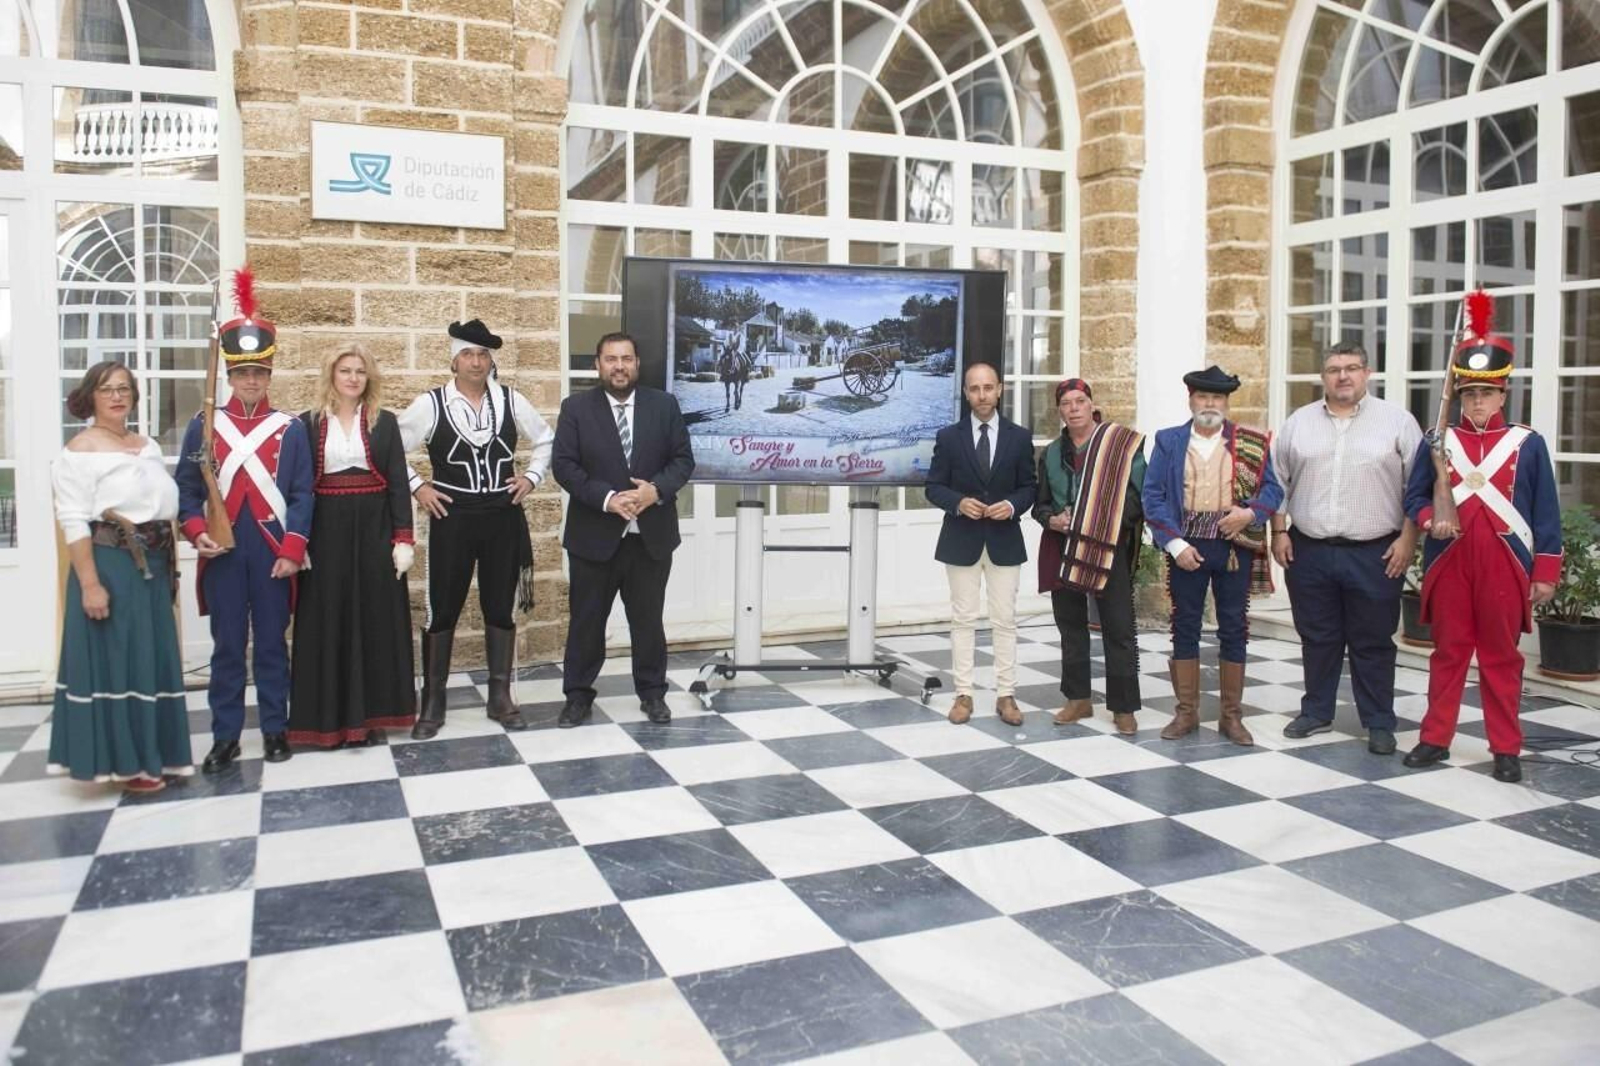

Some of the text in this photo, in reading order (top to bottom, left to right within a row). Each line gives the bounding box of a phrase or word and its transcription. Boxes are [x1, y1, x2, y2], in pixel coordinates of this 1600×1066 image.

[404, 156, 495, 181] Diputación
[404, 182, 479, 202] de Cádiz
[729, 434, 783, 455] Sangre
[786, 442, 795, 455] y
[750, 452, 884, 473] Amor en la Sierra
